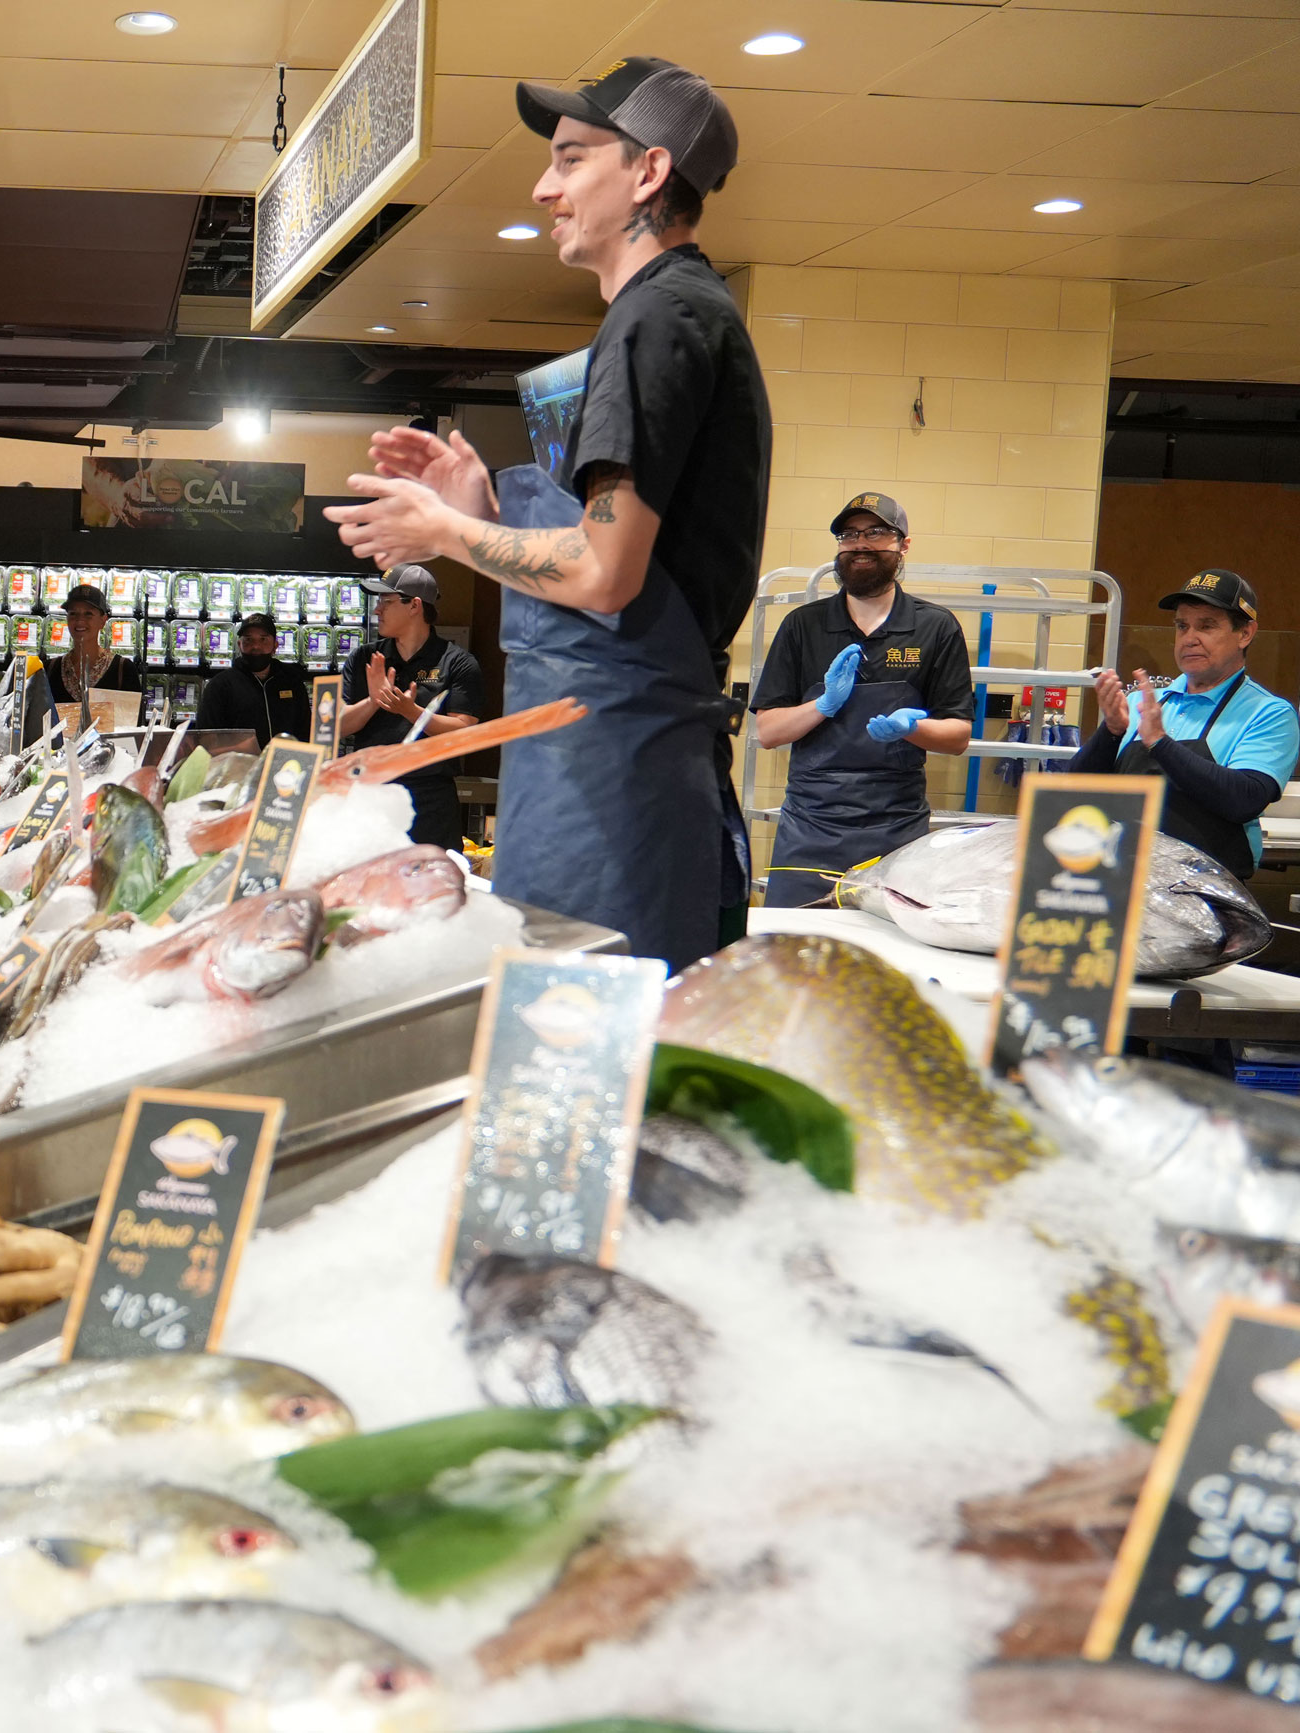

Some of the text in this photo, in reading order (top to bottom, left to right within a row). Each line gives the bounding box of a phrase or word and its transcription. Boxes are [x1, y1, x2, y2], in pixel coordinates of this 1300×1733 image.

[278, 80, 373, 256] SAKANAYA
[885, 647, 921, 663] 魚屋
[1188, 1474, 1300, 1542] GRE
[1188, 1518, 1300, 1580] SOL
